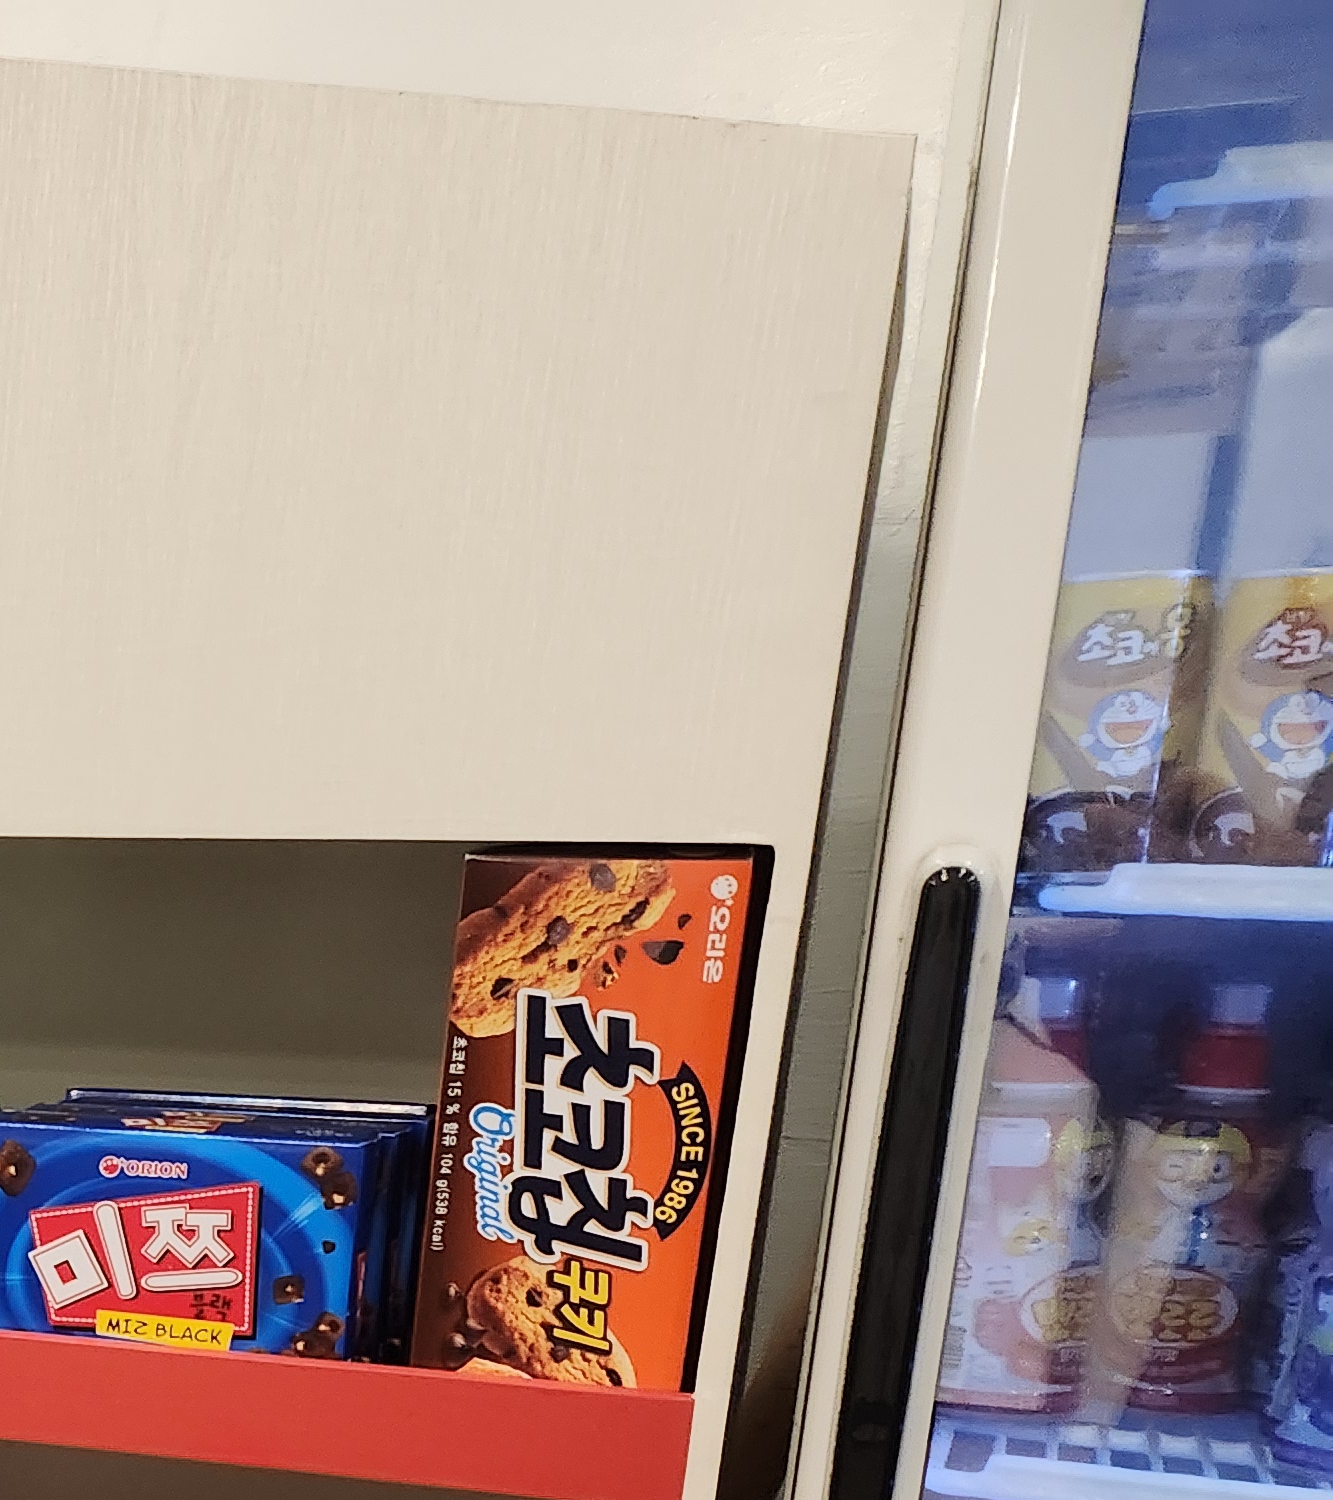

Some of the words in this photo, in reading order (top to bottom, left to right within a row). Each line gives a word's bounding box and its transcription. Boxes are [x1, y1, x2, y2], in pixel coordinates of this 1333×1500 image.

[701, 907, 732, 985] 오리온
[450, 1036, 467, 1077] 초코칩
[516, 992, 657, 1269] 초코칩
[671, 1080, 707, 1162] SINCE
[123, 1160, 188, 1181] ORION
[440, 1153, 455, 1175] 104
[469, 1104, 515, 1242] Original
[653, 1166, 700, 1228] 1986
[28, 1199, 244, 1310] 미쯔
[153, 1321, 224, 1346] BLACK
[552, 1260, 612, 1352] 쿠키
